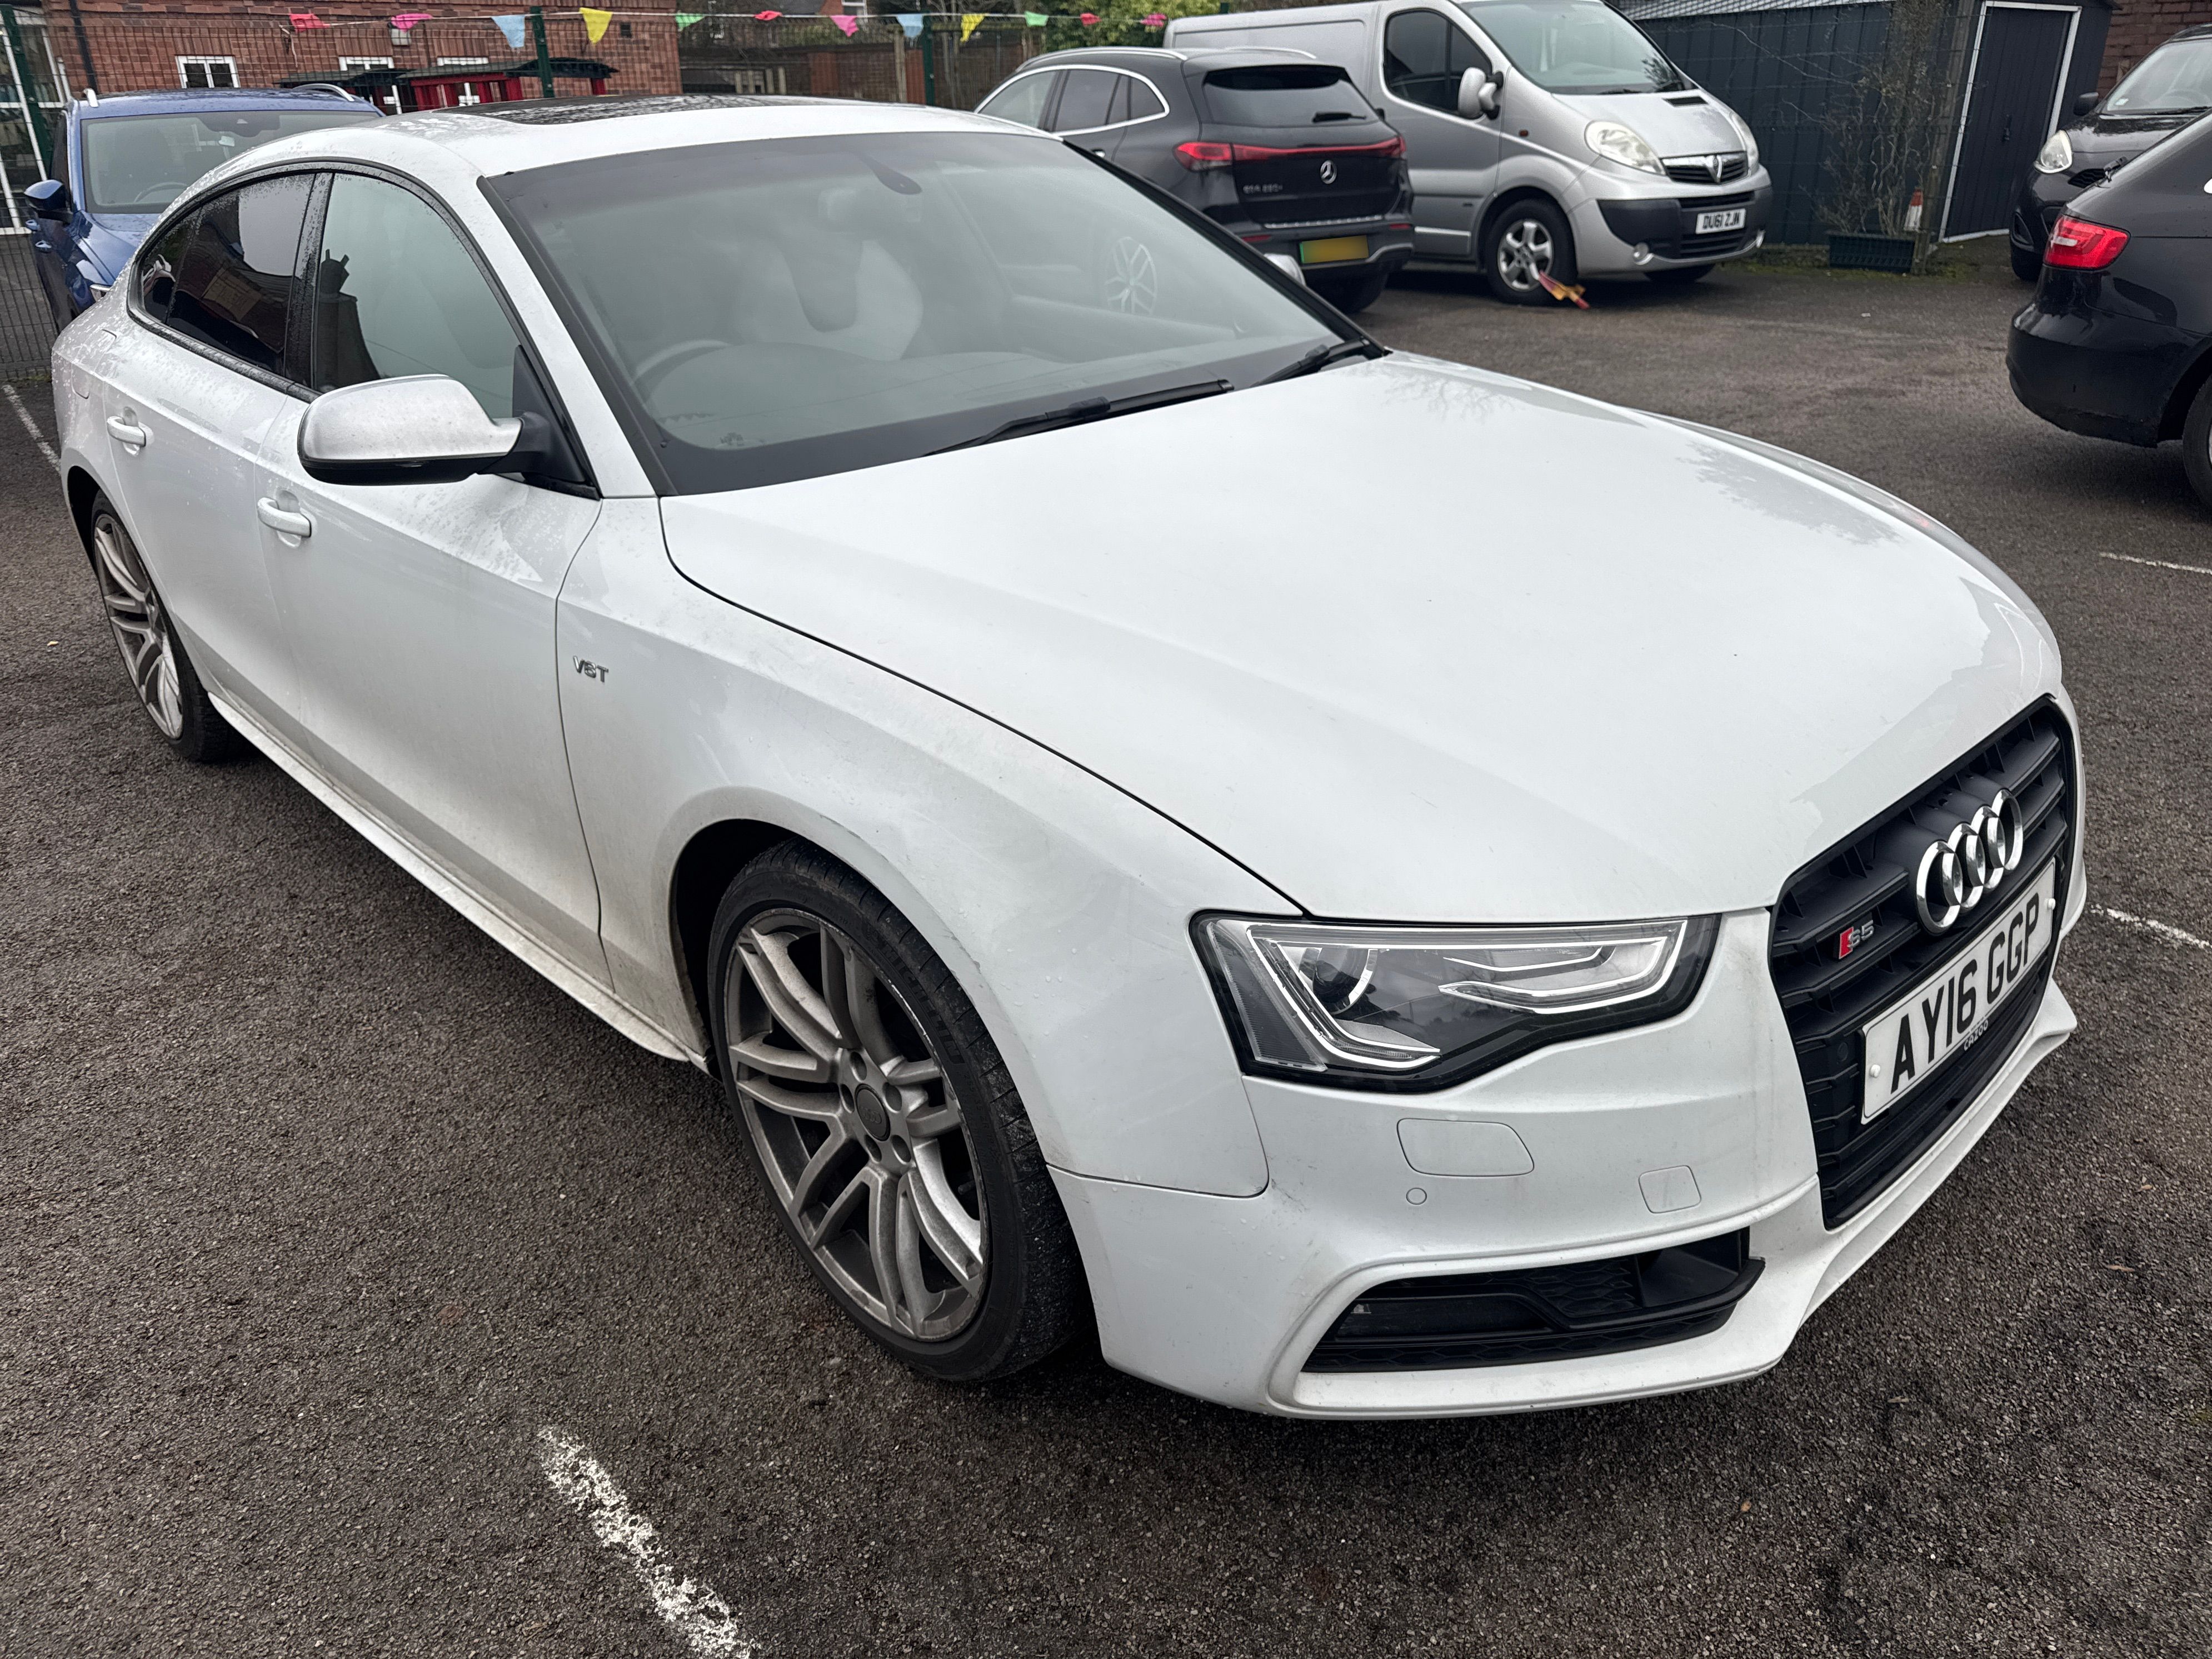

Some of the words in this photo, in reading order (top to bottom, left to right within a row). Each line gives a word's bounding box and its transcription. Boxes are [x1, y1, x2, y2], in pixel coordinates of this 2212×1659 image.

[1703, 214, 1722, 229] DU61
[1847, 920, 1874, 948] S5
[881, 943, 961, 1057] MICHELIN
[1891, 959, 1977, 1094] AY16
[1987, 893, 2038, 1005] GGP
[1964, 1019, 1988, 1051] CAZOO
